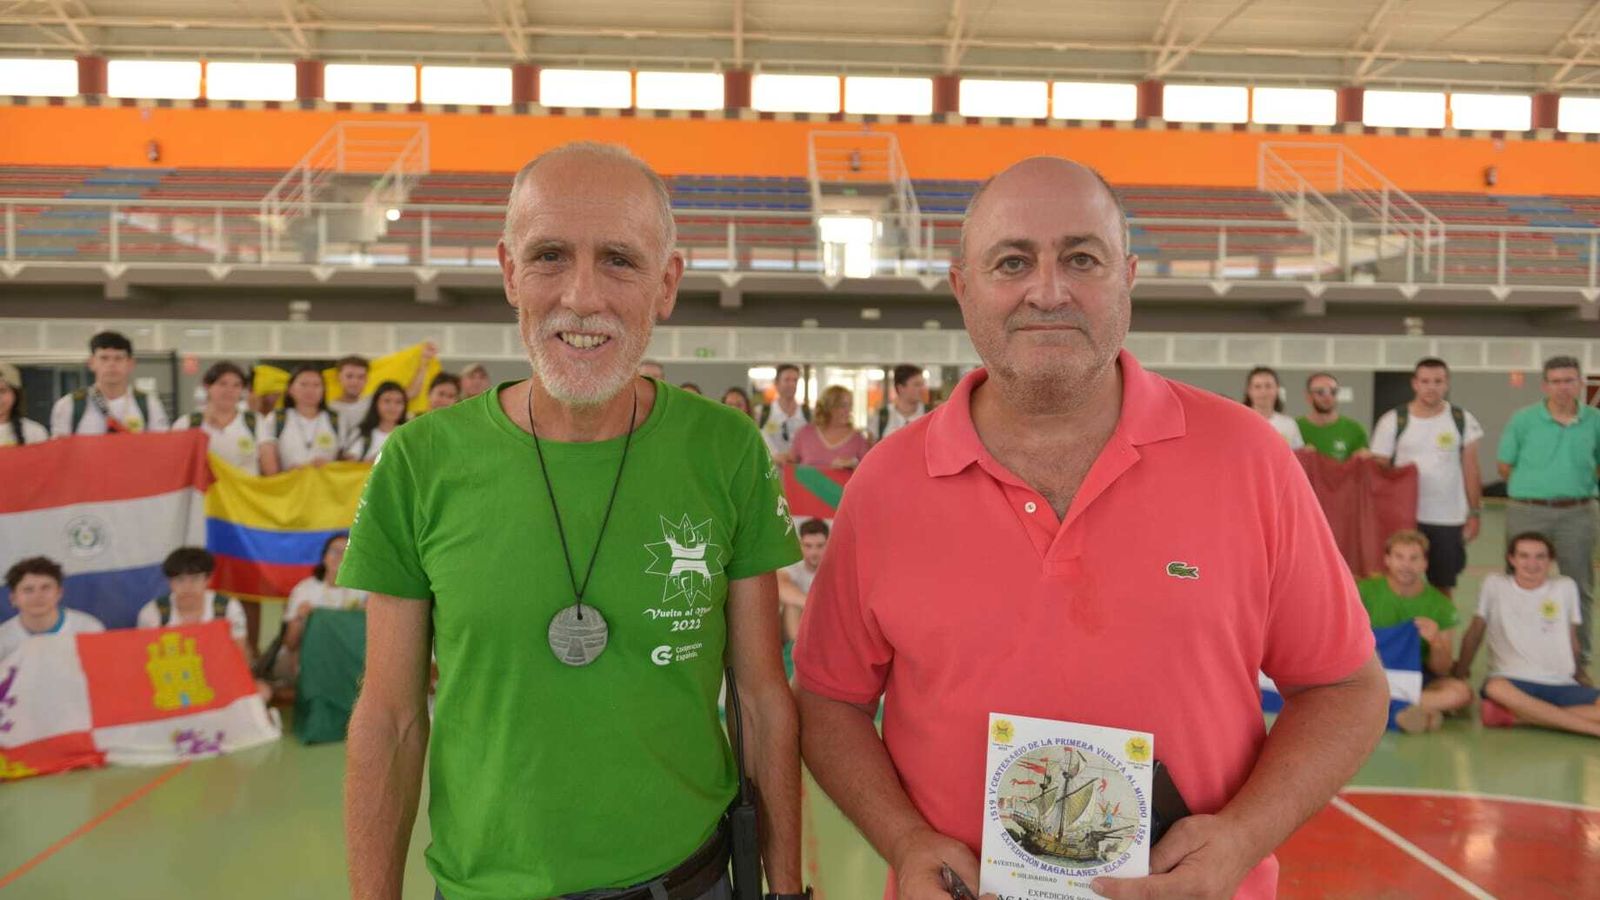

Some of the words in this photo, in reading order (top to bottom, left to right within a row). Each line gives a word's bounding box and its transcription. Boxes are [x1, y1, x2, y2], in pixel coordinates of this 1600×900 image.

[642, 608, 682, 620] Vuelta
[684, 608, 694, 616] al
[670, 618, 701, 632] 2022
[1027, 740, 1040, 750] DE
[1040, 738, 1053, 746] LA
[1055, 737, 1094, 752] PRIMERA
[990, 746, 1027, 787] CENTENARIO
[1096, 747, 1127, 774] VUELTA
[1125, 774, 1137, 787] AL
[1133, 787, 1148, 818] MUNDO
[988, 800, 999, 821] 1519
[1040, 863, 1099, 877] MAGALLANES
[1103, 852, 1131, 873] ELCANO
